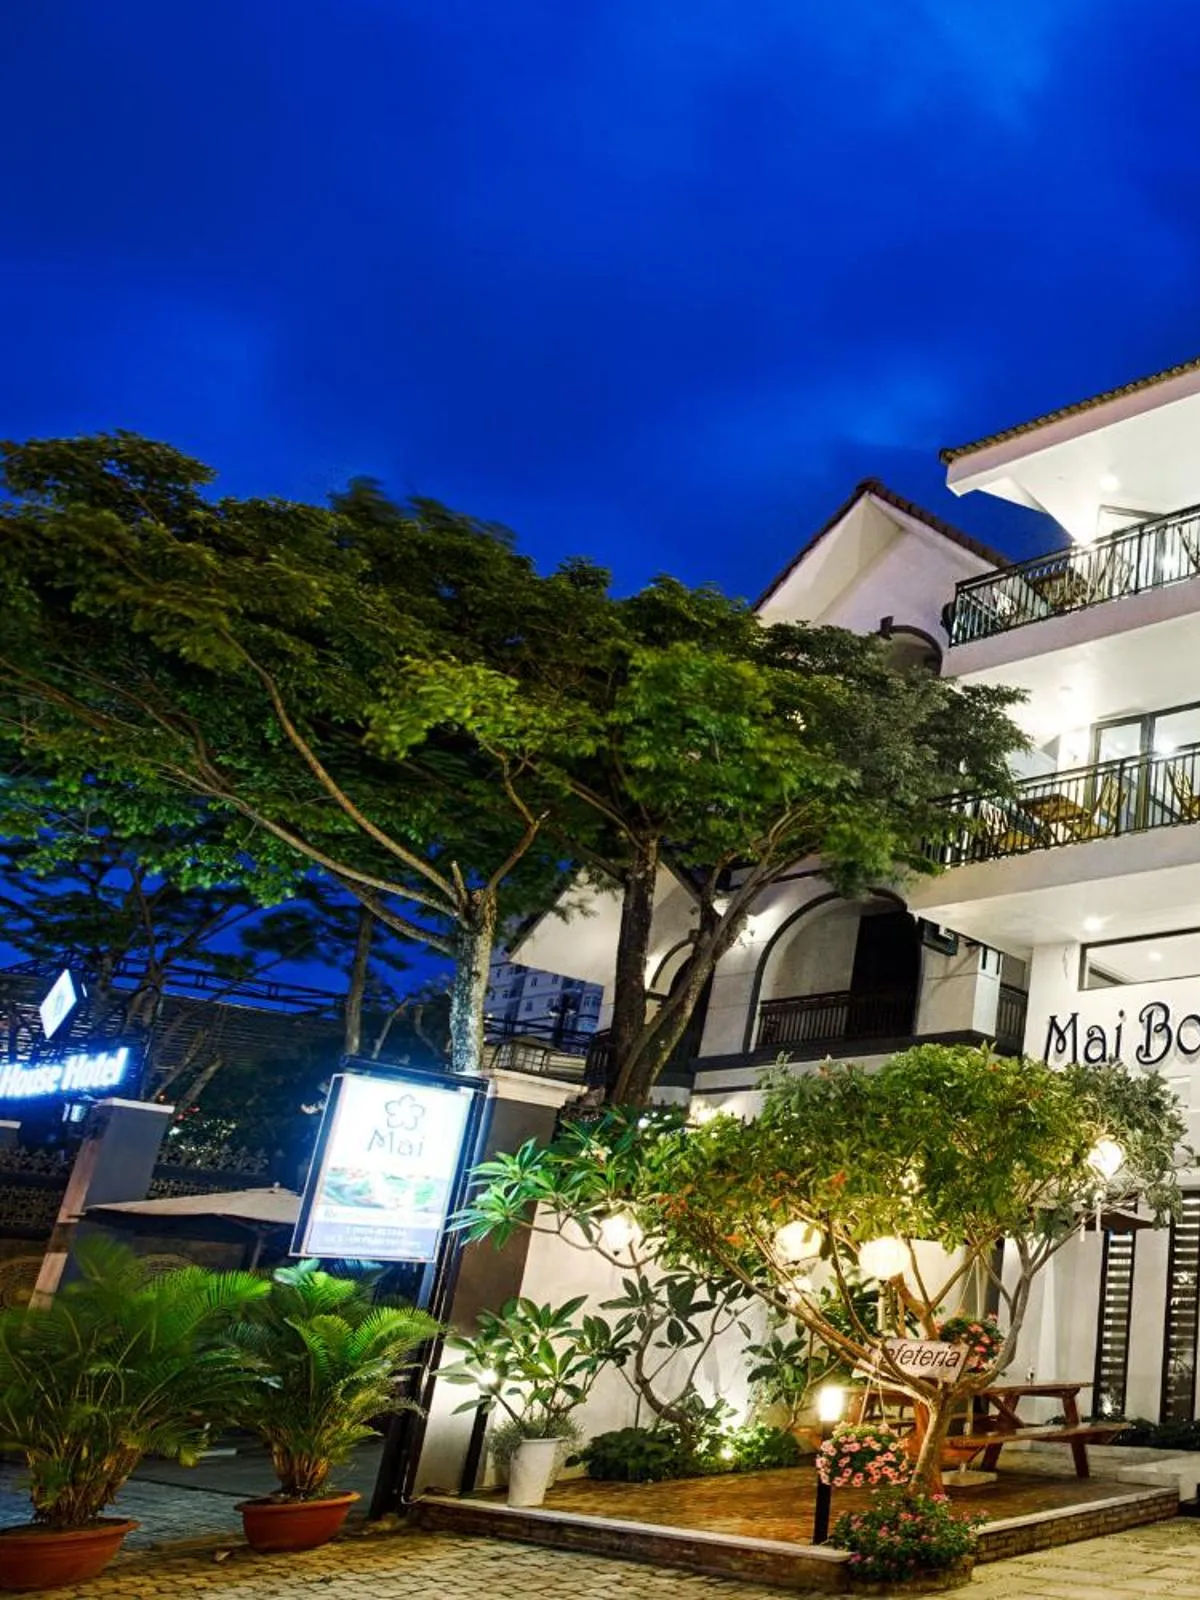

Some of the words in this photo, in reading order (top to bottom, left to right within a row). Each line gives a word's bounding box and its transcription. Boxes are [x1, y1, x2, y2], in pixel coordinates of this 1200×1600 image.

[1044, 1009, 1127, 1067] Mai
[61, 1048, 128, 1090] Hotel
[367, 1129, 425, 1158] Mai
